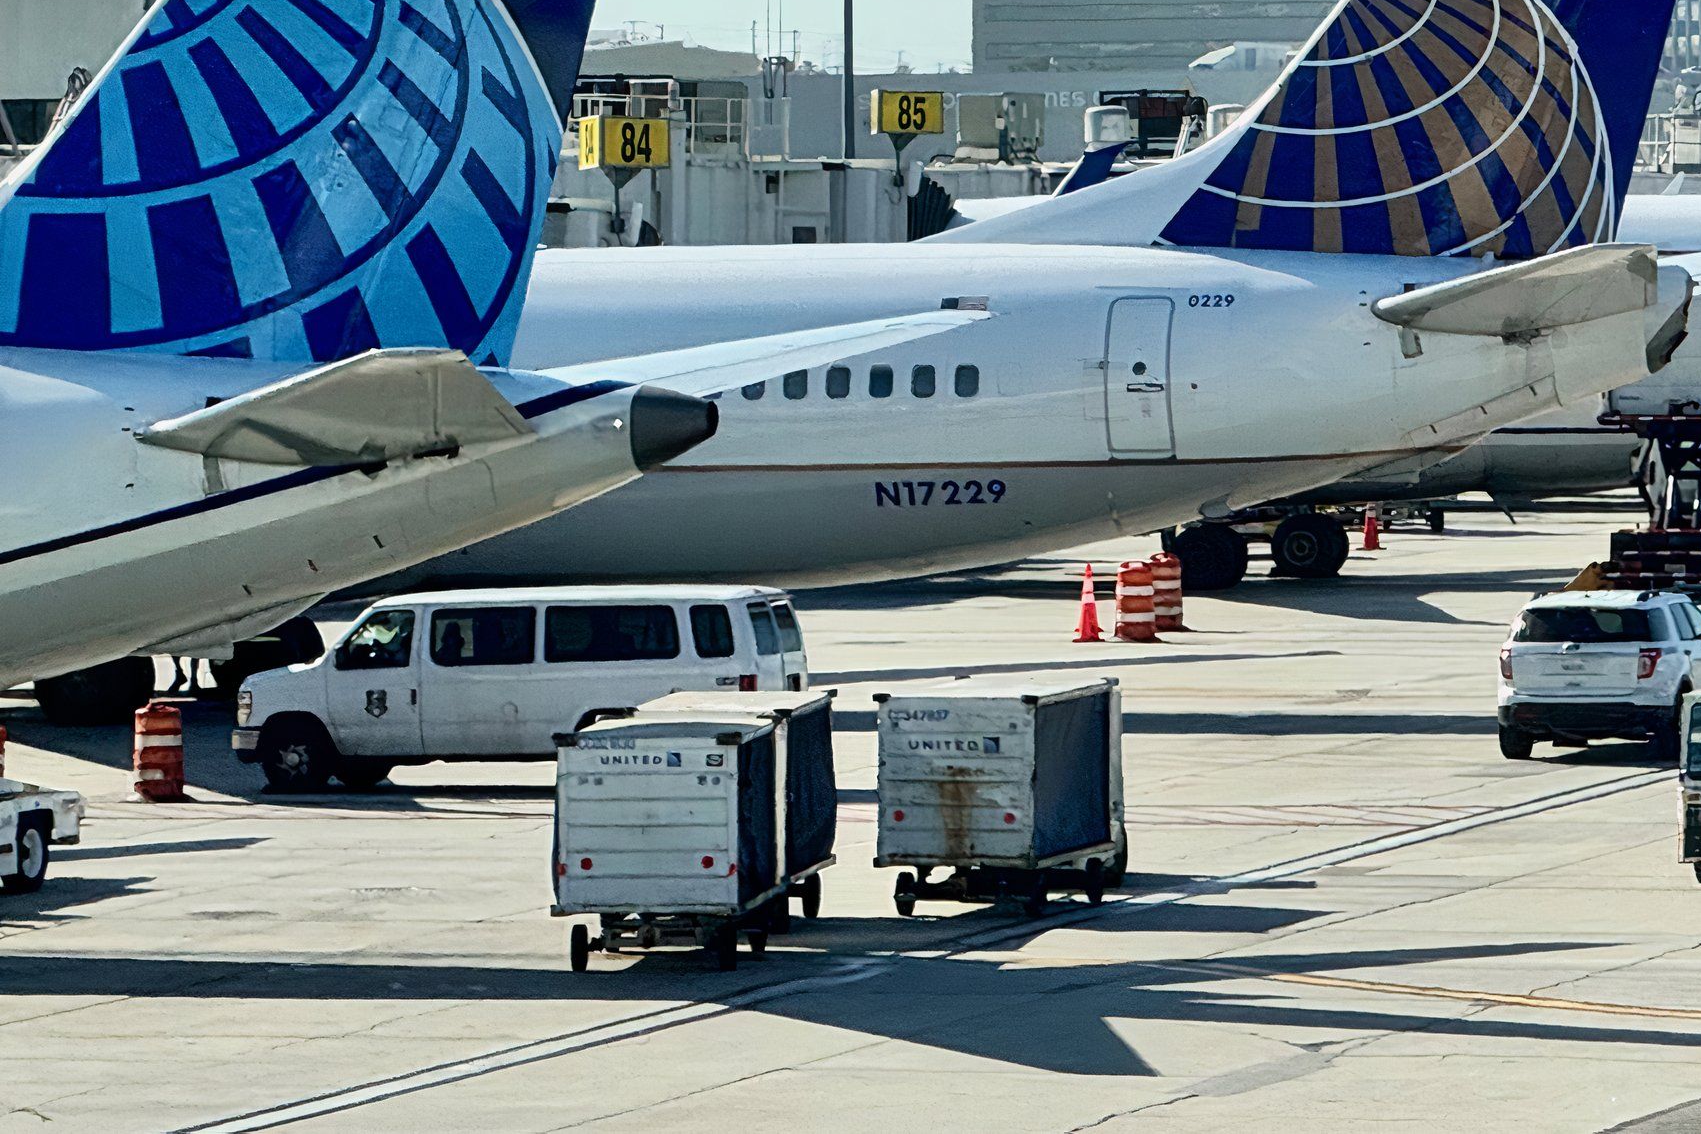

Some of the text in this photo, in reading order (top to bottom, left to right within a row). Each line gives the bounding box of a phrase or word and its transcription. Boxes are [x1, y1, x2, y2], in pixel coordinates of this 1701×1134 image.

[898, 95, 926, 130] 85
[621, 122, 652, 163] 84
[1188, 294, 1235, 307] 0229
[875, 479, 1007, 506] N17229
[908, 740, 979, 751] UNITED
[600, 755, 663, 765] UNITED
